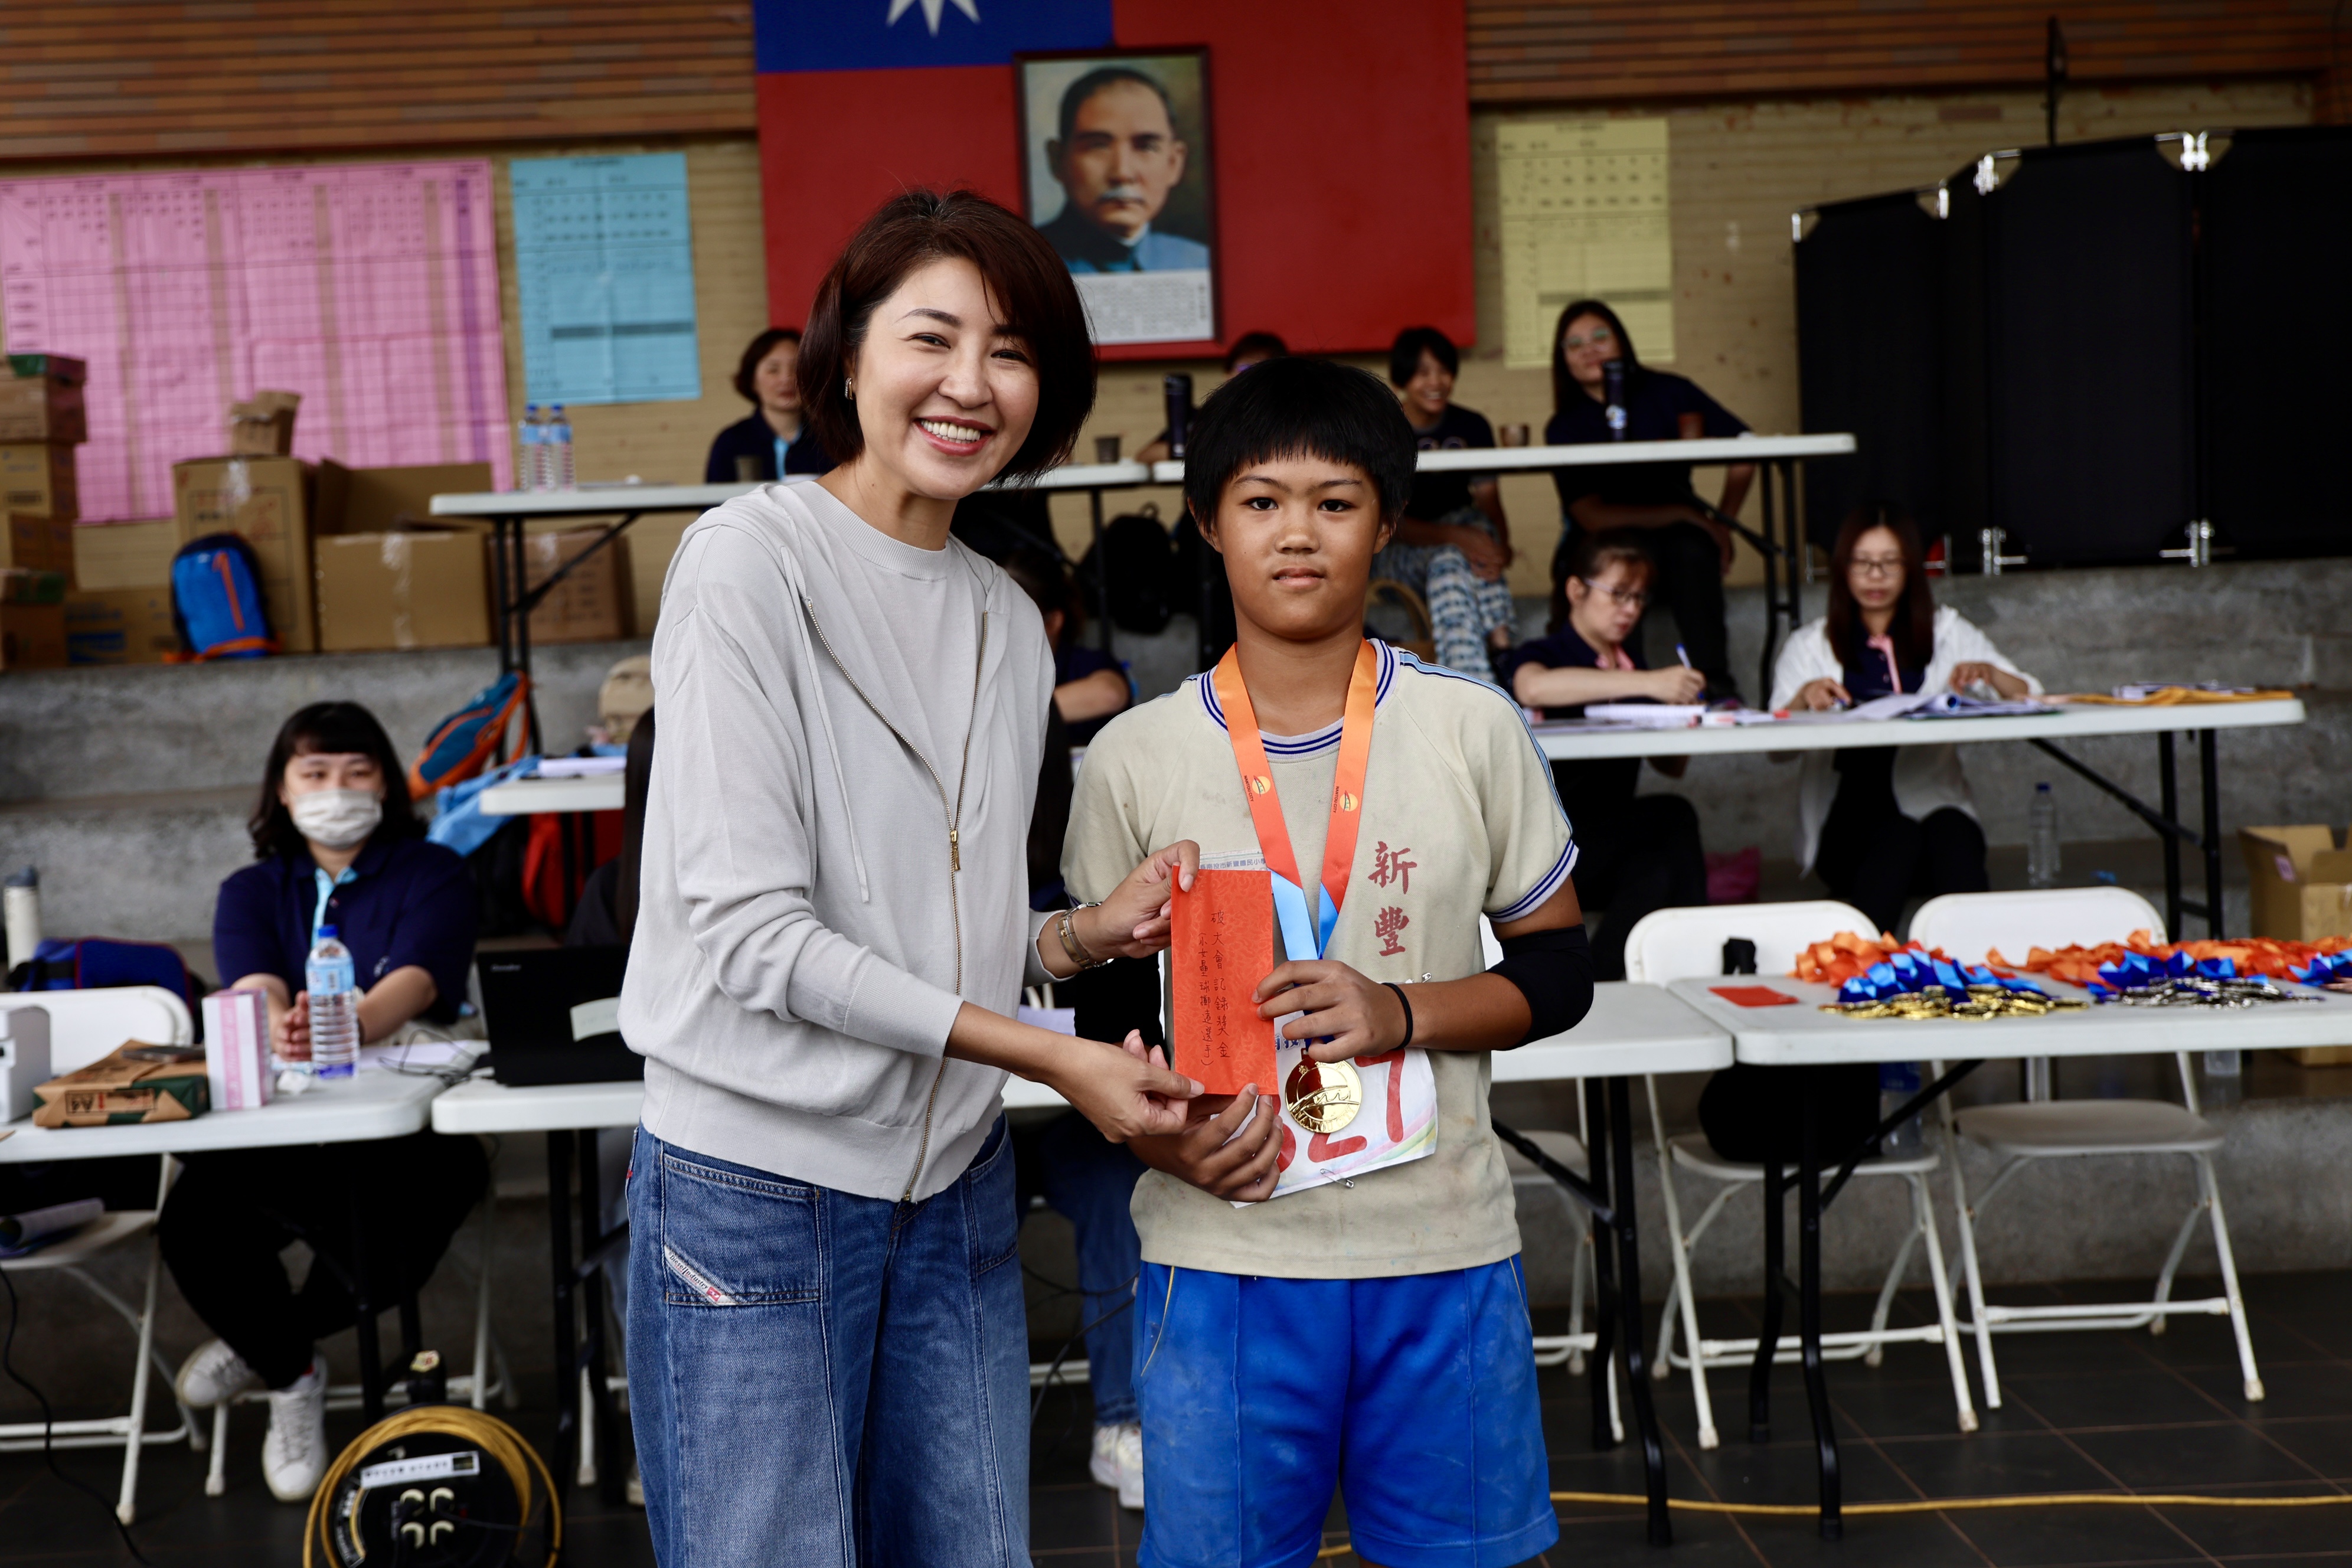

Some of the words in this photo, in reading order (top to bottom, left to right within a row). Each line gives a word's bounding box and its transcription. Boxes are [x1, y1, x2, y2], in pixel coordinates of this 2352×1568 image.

[1368, 841, 1417, 956] 新豐
[1210, 910, 1230, 1058] 破大會記錄獎金
